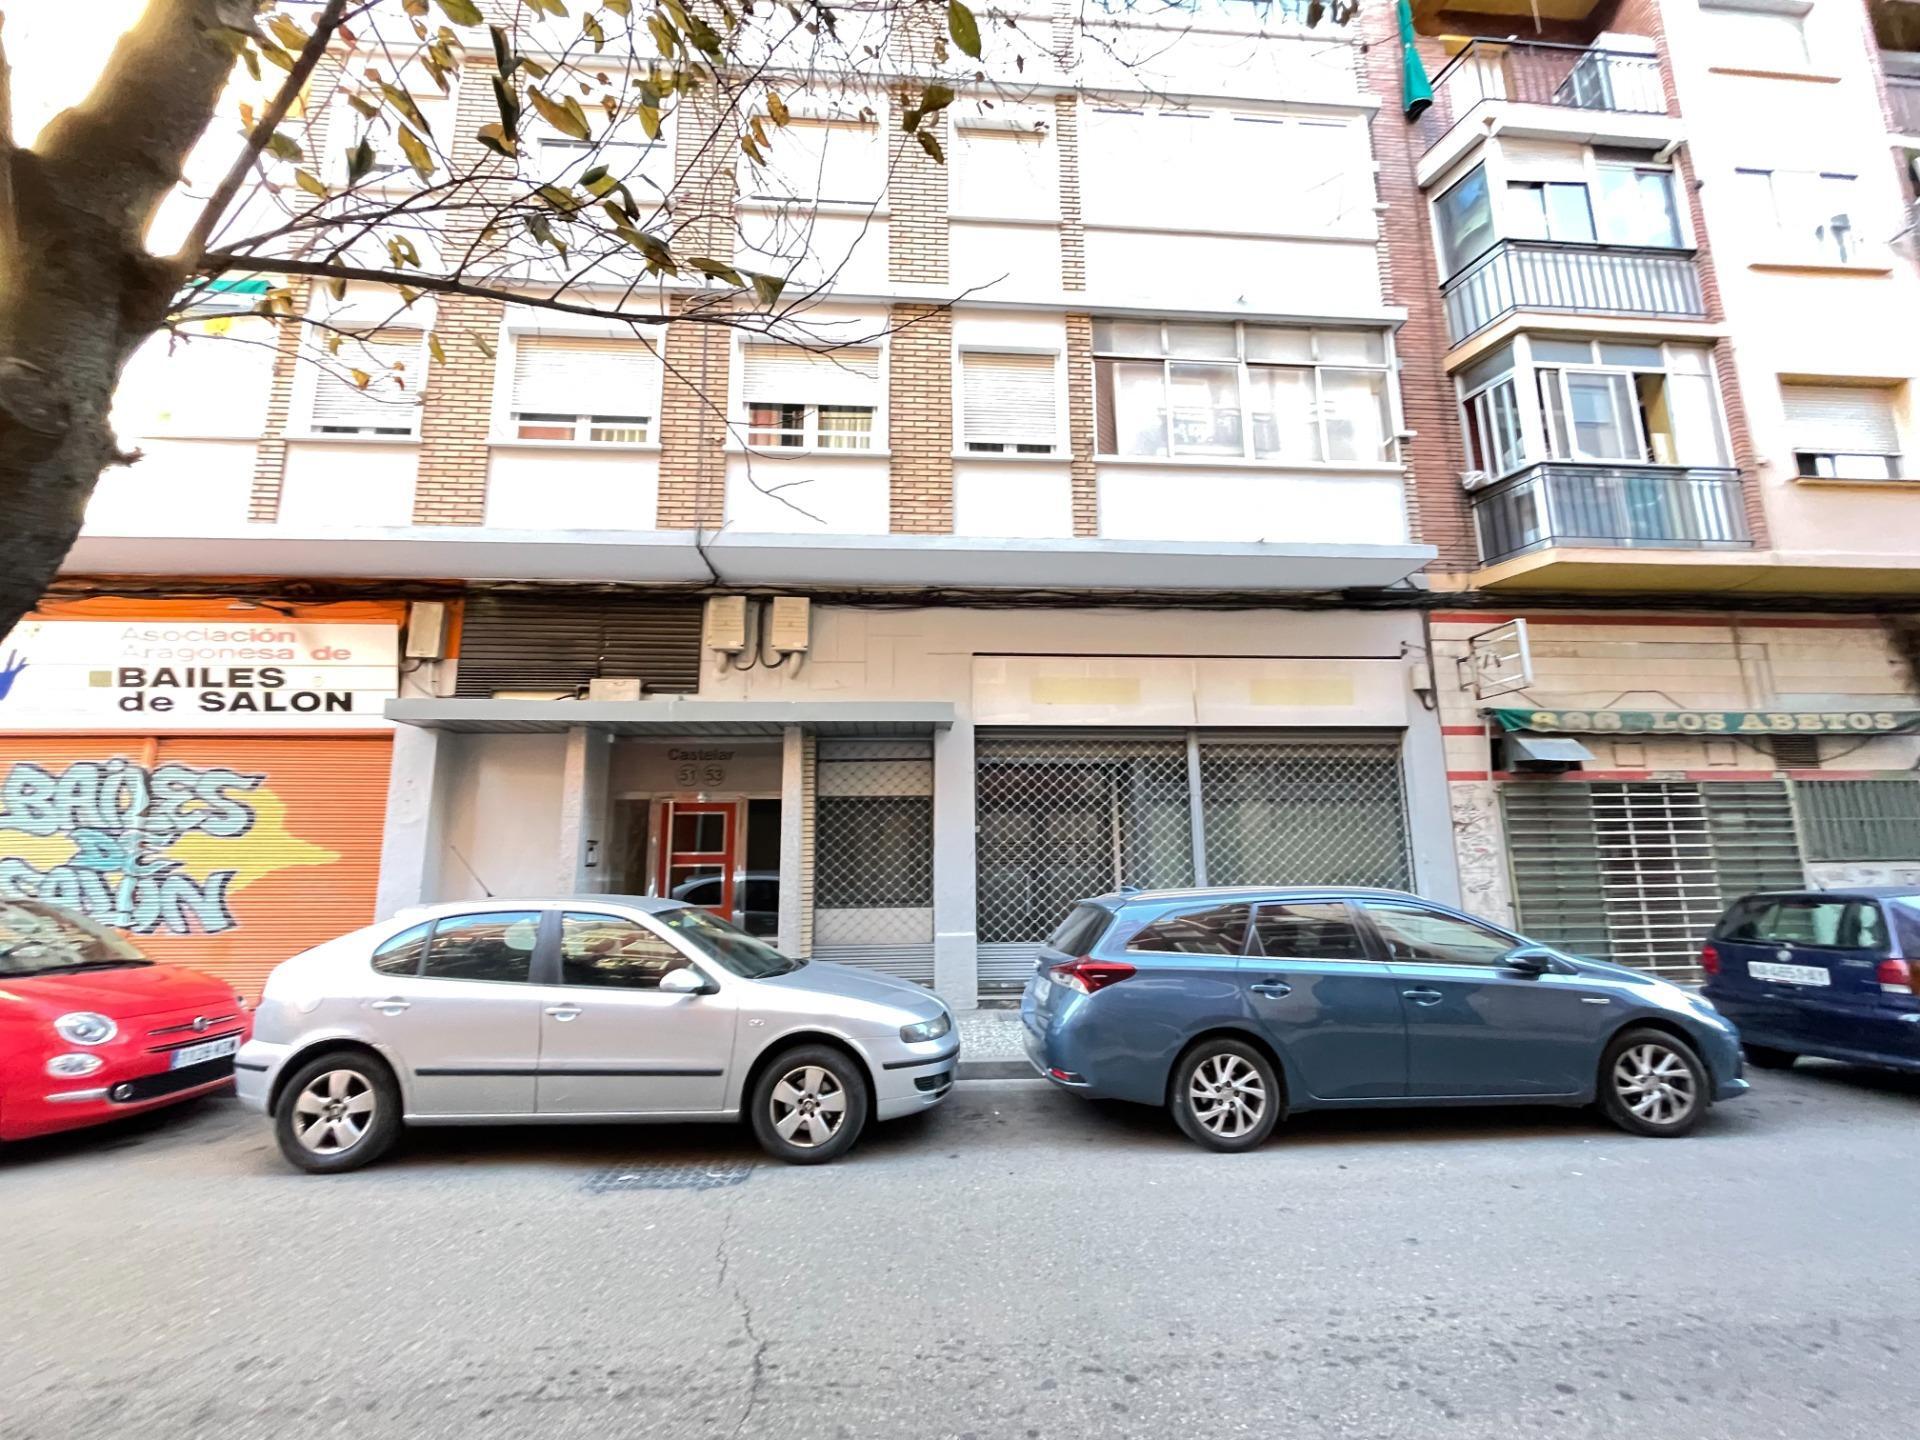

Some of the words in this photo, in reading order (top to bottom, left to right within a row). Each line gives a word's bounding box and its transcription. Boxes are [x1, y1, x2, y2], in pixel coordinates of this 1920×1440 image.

[121, 627, 297, 643] Asociación
[122, 645, 295, 662] Aragonesa
[311, 646, 352, 661] de
[118, 667, 286, 688] BAILES
[119, 691, 175, 712] de
[199, 691, 353, 712] SALON
[1652, 713, 1727, 730] LOS
[1738, 713, 1898, 730] ABETOS
[667, 748, 736, 761] Castelar
[679, 769, 696, 781] 51
[705, 769, 723, 781] 53
